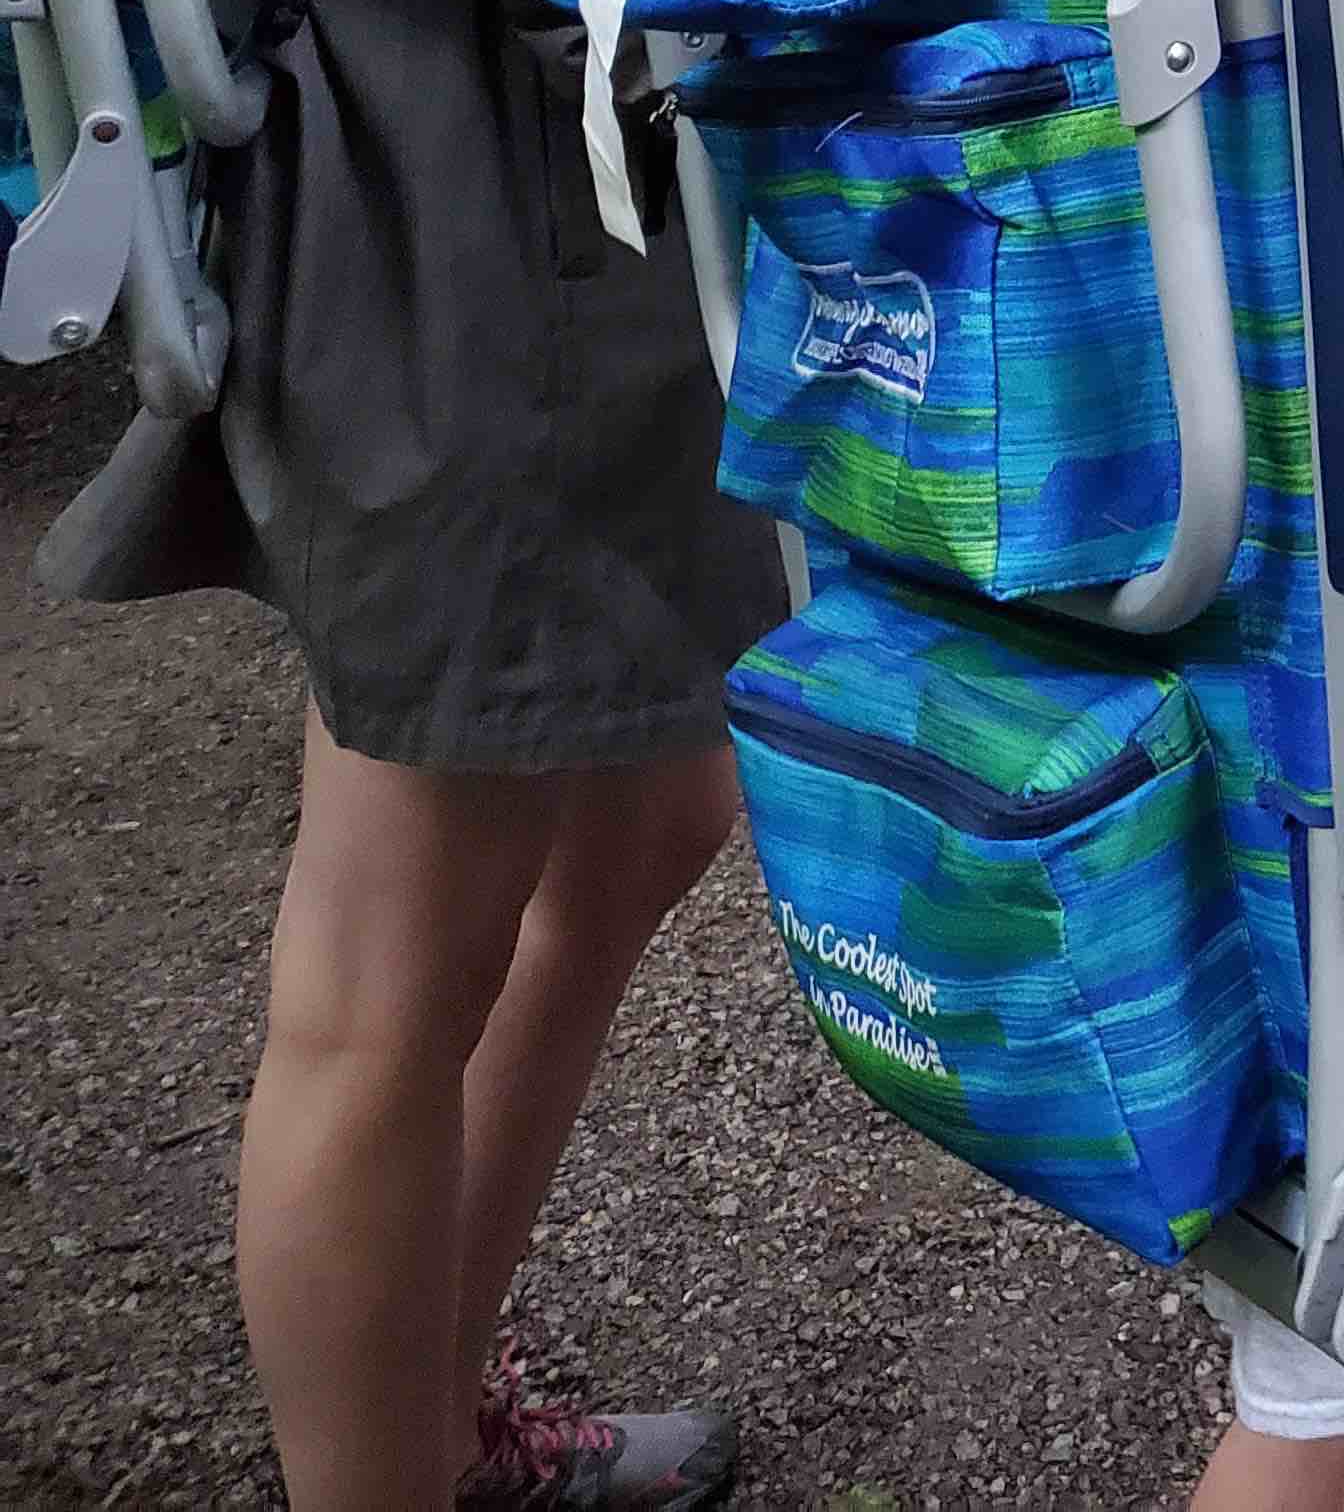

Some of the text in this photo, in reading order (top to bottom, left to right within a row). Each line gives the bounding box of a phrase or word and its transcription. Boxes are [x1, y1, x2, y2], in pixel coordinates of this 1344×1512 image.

[779, 899, 815, 952] The
[817, 923, 898, 993] Coolest
[830, 990, 929, 1072] Paradise
